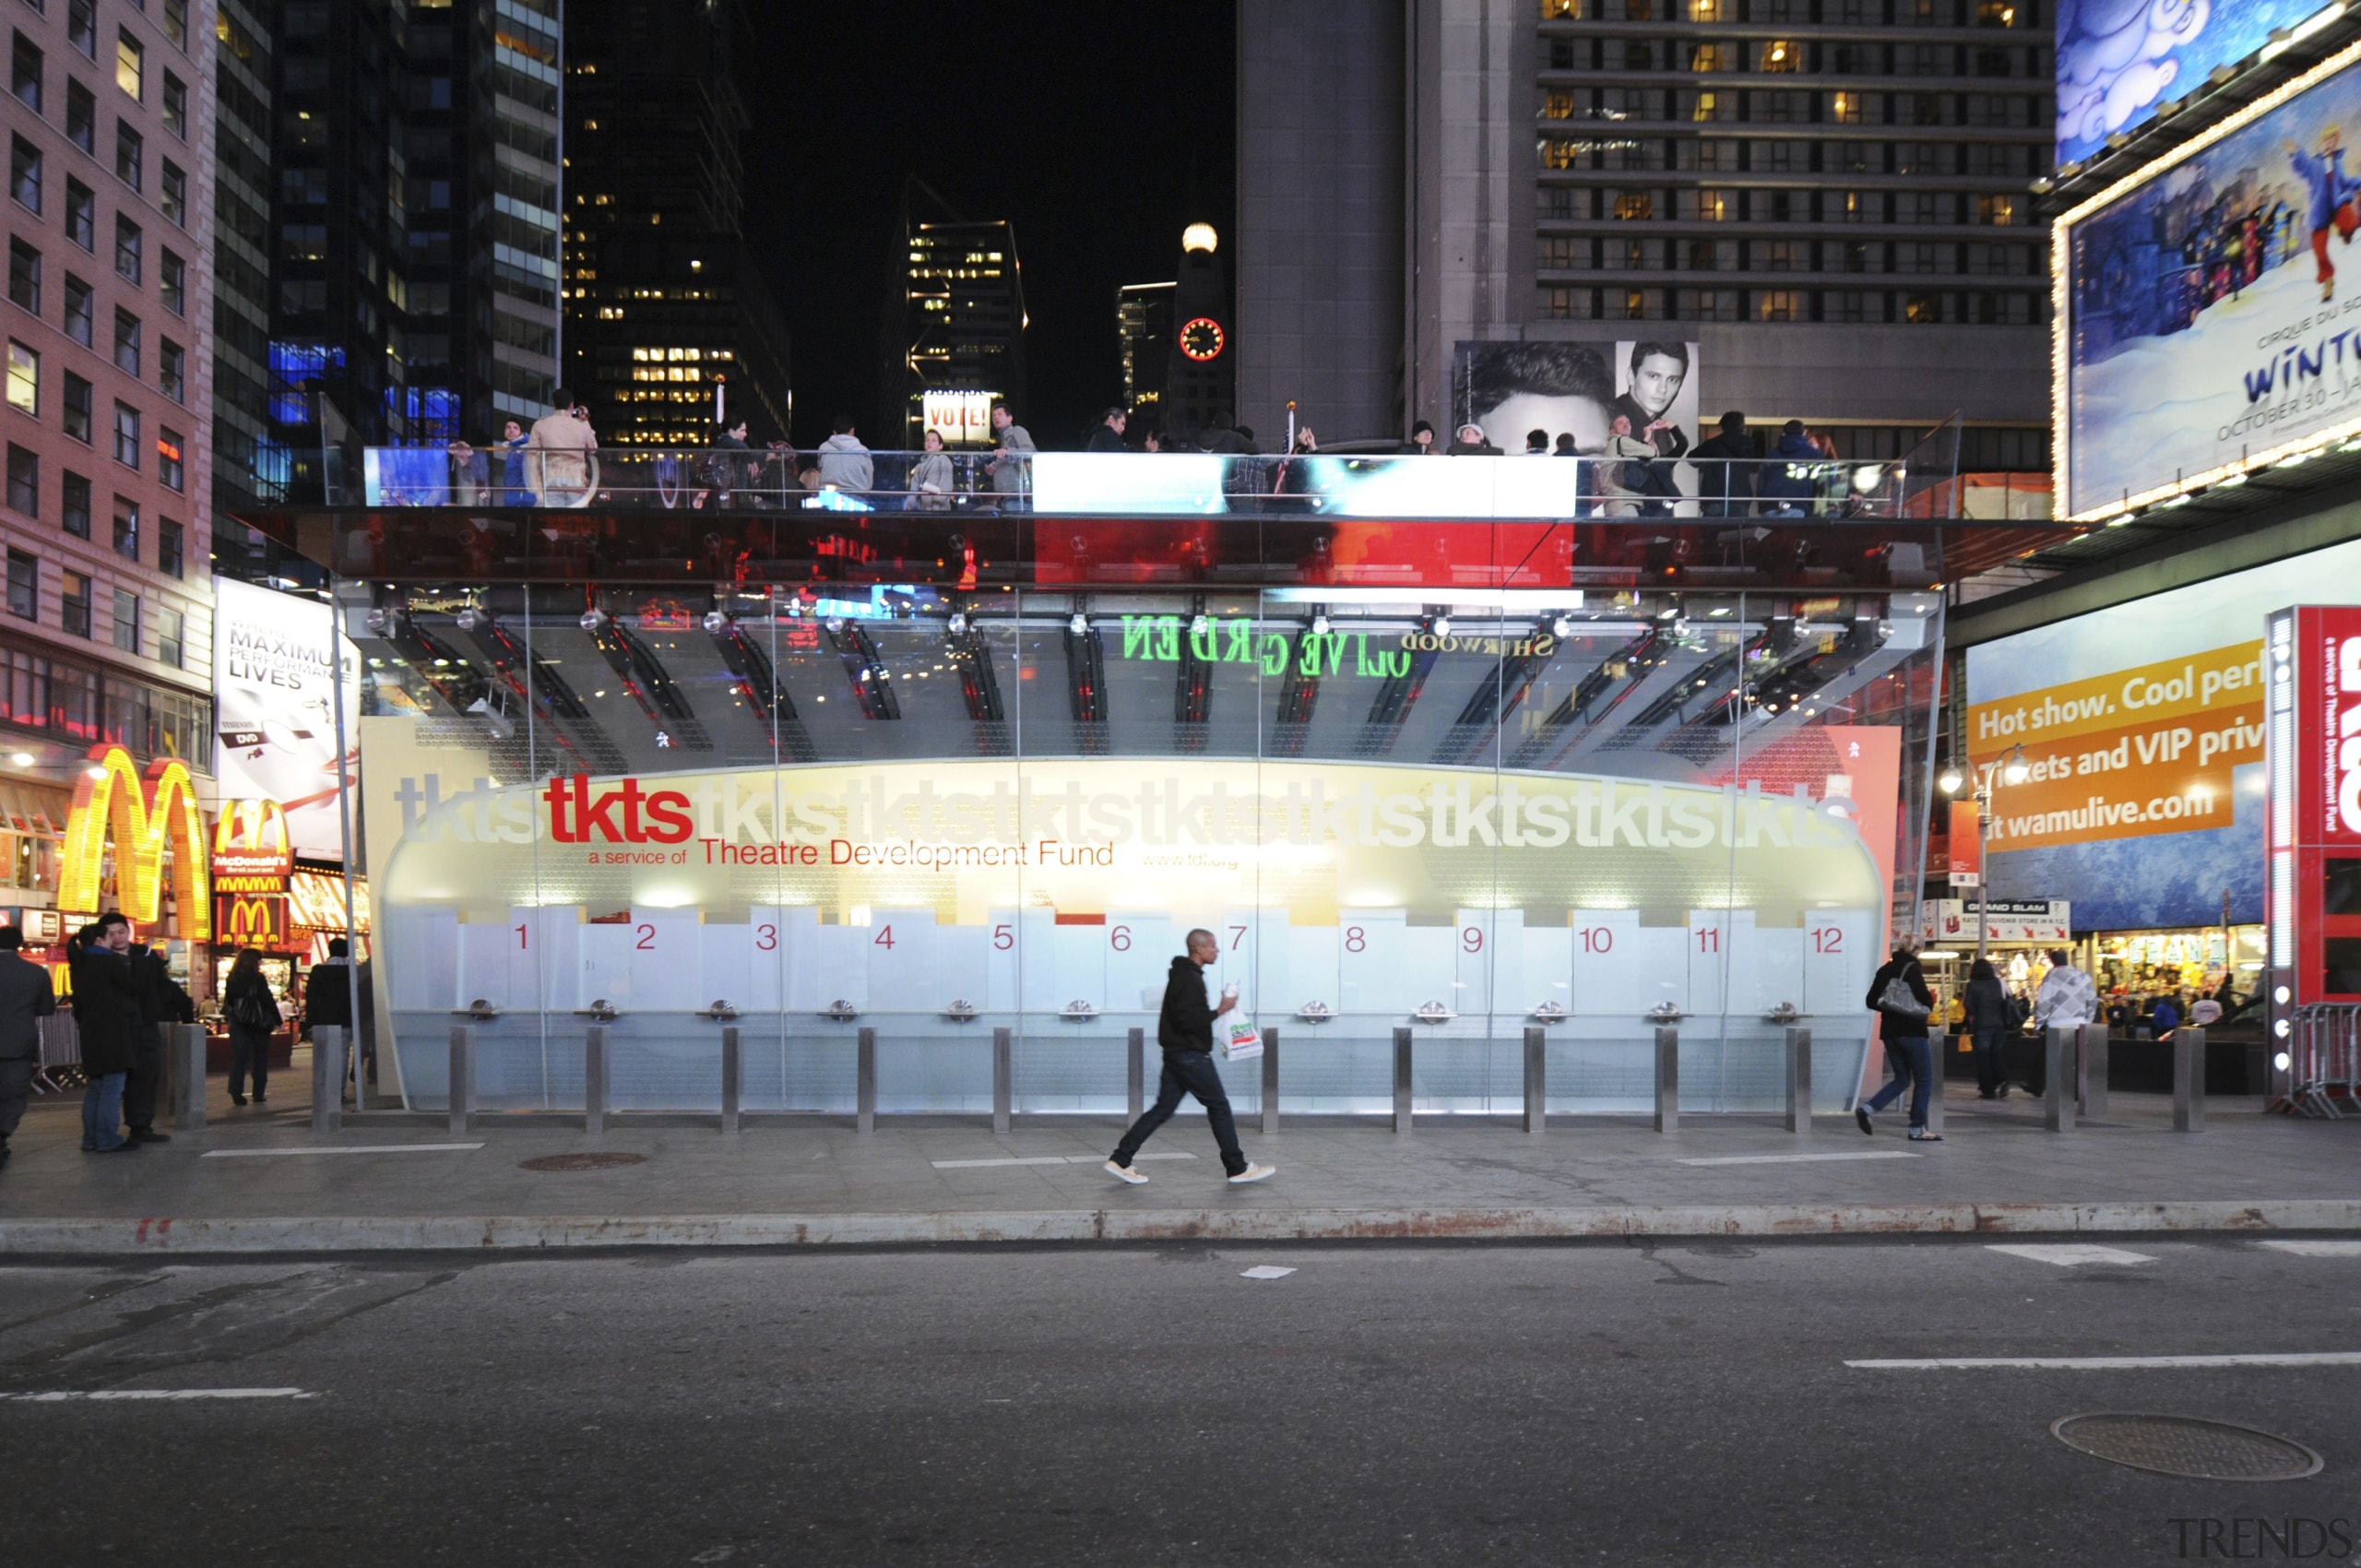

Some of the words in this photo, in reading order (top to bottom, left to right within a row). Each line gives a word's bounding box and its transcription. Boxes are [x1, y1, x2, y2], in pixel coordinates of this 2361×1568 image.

[2258, 317, 2312, 350] CIRQUE
[2316, 306, 2339, 325] DU
[931, 407, 986, 427] VOTE!
[2217, 398, 2301, 442] OCTOBER
[2305, 389, 2326, 411] 30
[229, 659, 303, 690] LIVES
[2324, 646, 2337, 683] service
[1979, 707, 2027, 740] Hot
[2031, 696, 2116, 730] show.
[2122, 665, 2194, 709] Cool
[2324, 684, 2339, 695] of
[2324, 696, 2339, 736] Theatre
[235, 733, 259, 744] DVD
[2077, 736, 2130, 776] and
[2134, 728, 2193, 766] VIP
[2199, 716, 2265, 766] priv
[2323, 739, 2339, 803] Development
[543, 773, 694, 844] tkts
[2008, 794, 2214, 837] wamulive.com
[2324, 806, 2339, 832] Fund
[214, 856, 287, 867] McDonald's
[588, 852, 599, 863] a
[605, 848, 665, 864] service
[670, 848, 687, 863] of
[697, 837, 818, 865] Theatre
[830, 838, 1027, 871] Development
[1039, 840, 1113, 866] Fund
[514, 924, 528, 949] 1
[636, 924, 656, 949] 2
[755, 924, 777, 950] 3
[874, 925, 896, 950] 4
[993, 925, 1014, 950] 5
[1110, 926, 1132, 951] 6
[1228, 926, 1248, 951] 7
[1345, 927, 1367, 952] 8
[1463, 927, 1483, 953] 9
[1578, 927, 1613, 953] 10
[1694, 927, 1719, 953] 11
[1810, 927, 1843, 953] 12
